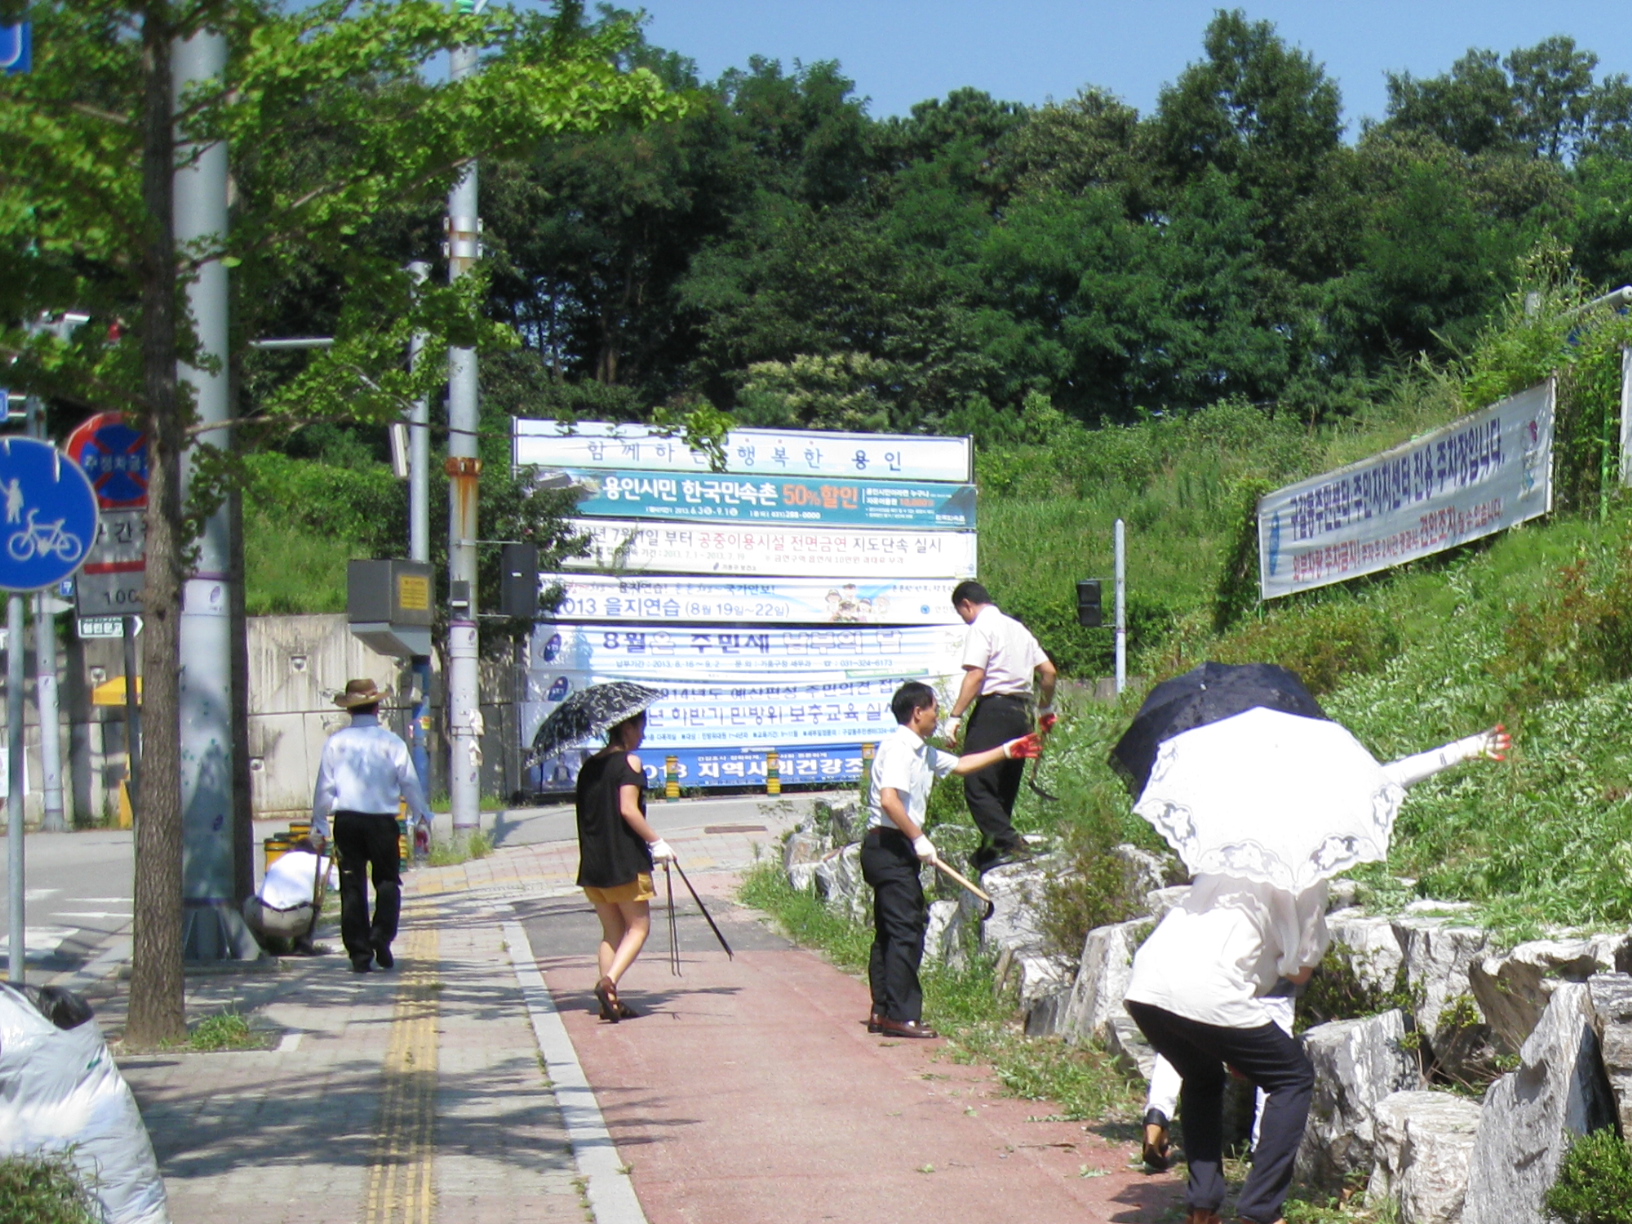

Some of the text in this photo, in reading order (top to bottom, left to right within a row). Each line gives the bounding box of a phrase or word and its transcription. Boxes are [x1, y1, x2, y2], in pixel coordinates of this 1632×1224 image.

[738, 445, 823, 469] 행복한
[852, 450, 902, 471] 용인
[1414, 443, 1434, 501] 전용
[602, 476, 678, 502] 용인시민
[681, 478, 778, 507] 한국민속촌
[665, 531, 693, 546] 부터
[699, 532, 785, 551] 공중이용시설
[791, 534, 848, 552] 전면금연
[853, 537, 909, 554] 지도단속
[914, 537, 942, 554] 실시
[604, 597, 681, 617] 을지연습
[603, 630, 902, 655] 8월은 주민세 납부의 날
[660, 687, 723, 700] 014년도
[806, 681, 871, 699] 주민의견
[671, 706, 724, 726] 하반기
[731, 705, 782, 726] 민방위
[790, 702, 859, 725] 보충교육
